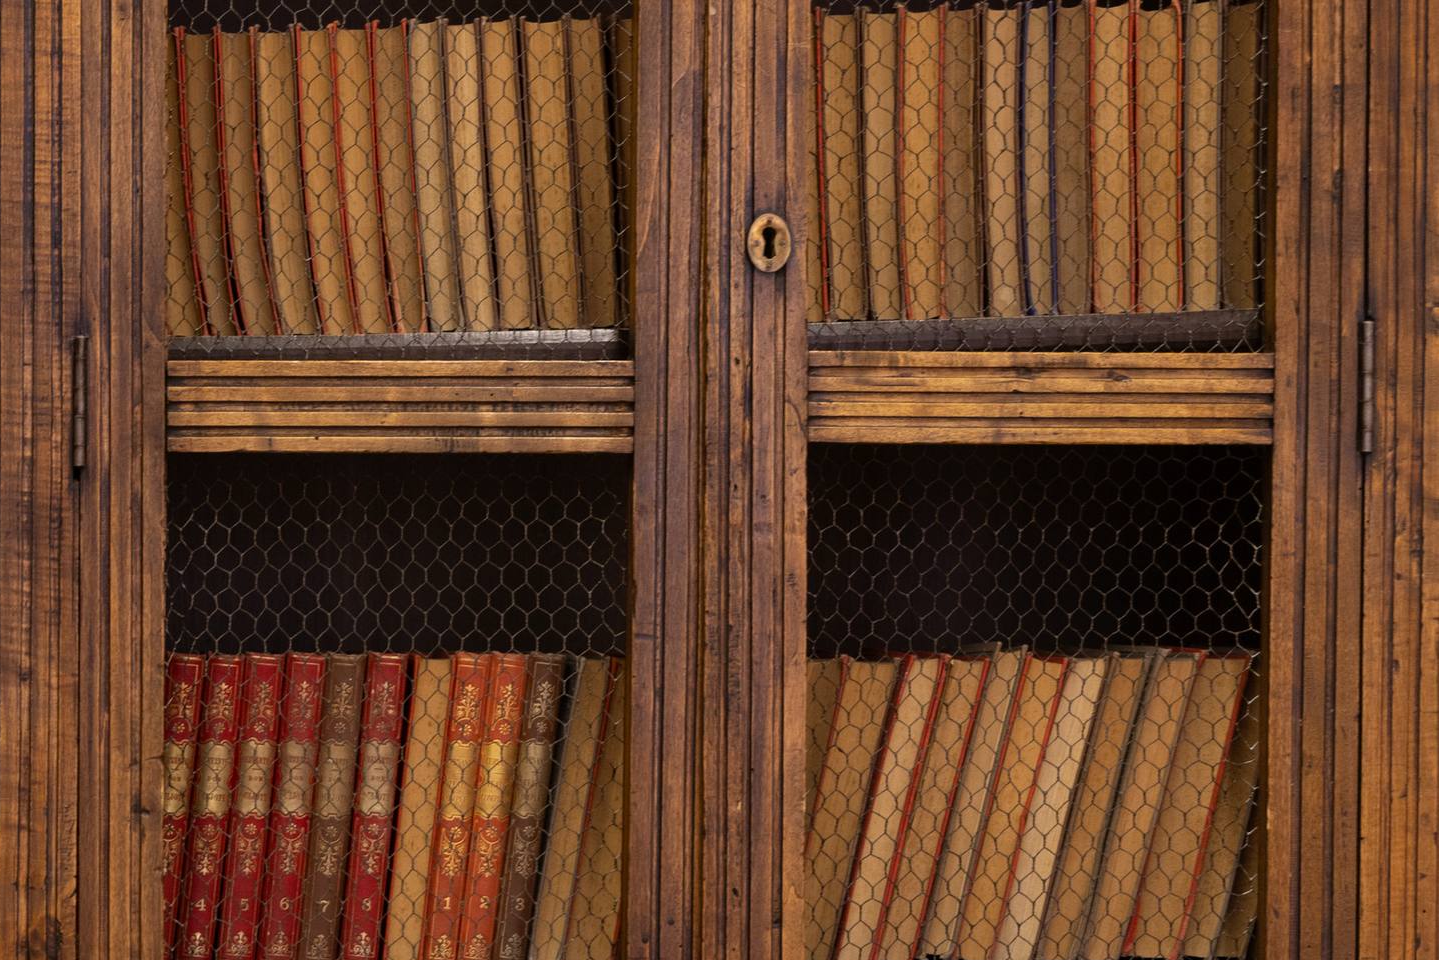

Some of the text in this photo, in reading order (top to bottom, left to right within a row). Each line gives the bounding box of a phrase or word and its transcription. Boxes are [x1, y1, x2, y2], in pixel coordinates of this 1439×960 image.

[194, 898, 207, 912] 4
[240, 898, 250, 912] 5
[279, 898, 290, 911] 6
[319, 899, 331, 913] 7
[361, 899, 372, 912] 8
[442, 896, 452, 910] 1
[479, 896, 491, 909] 2
[515, 897, 526, 911] 3
